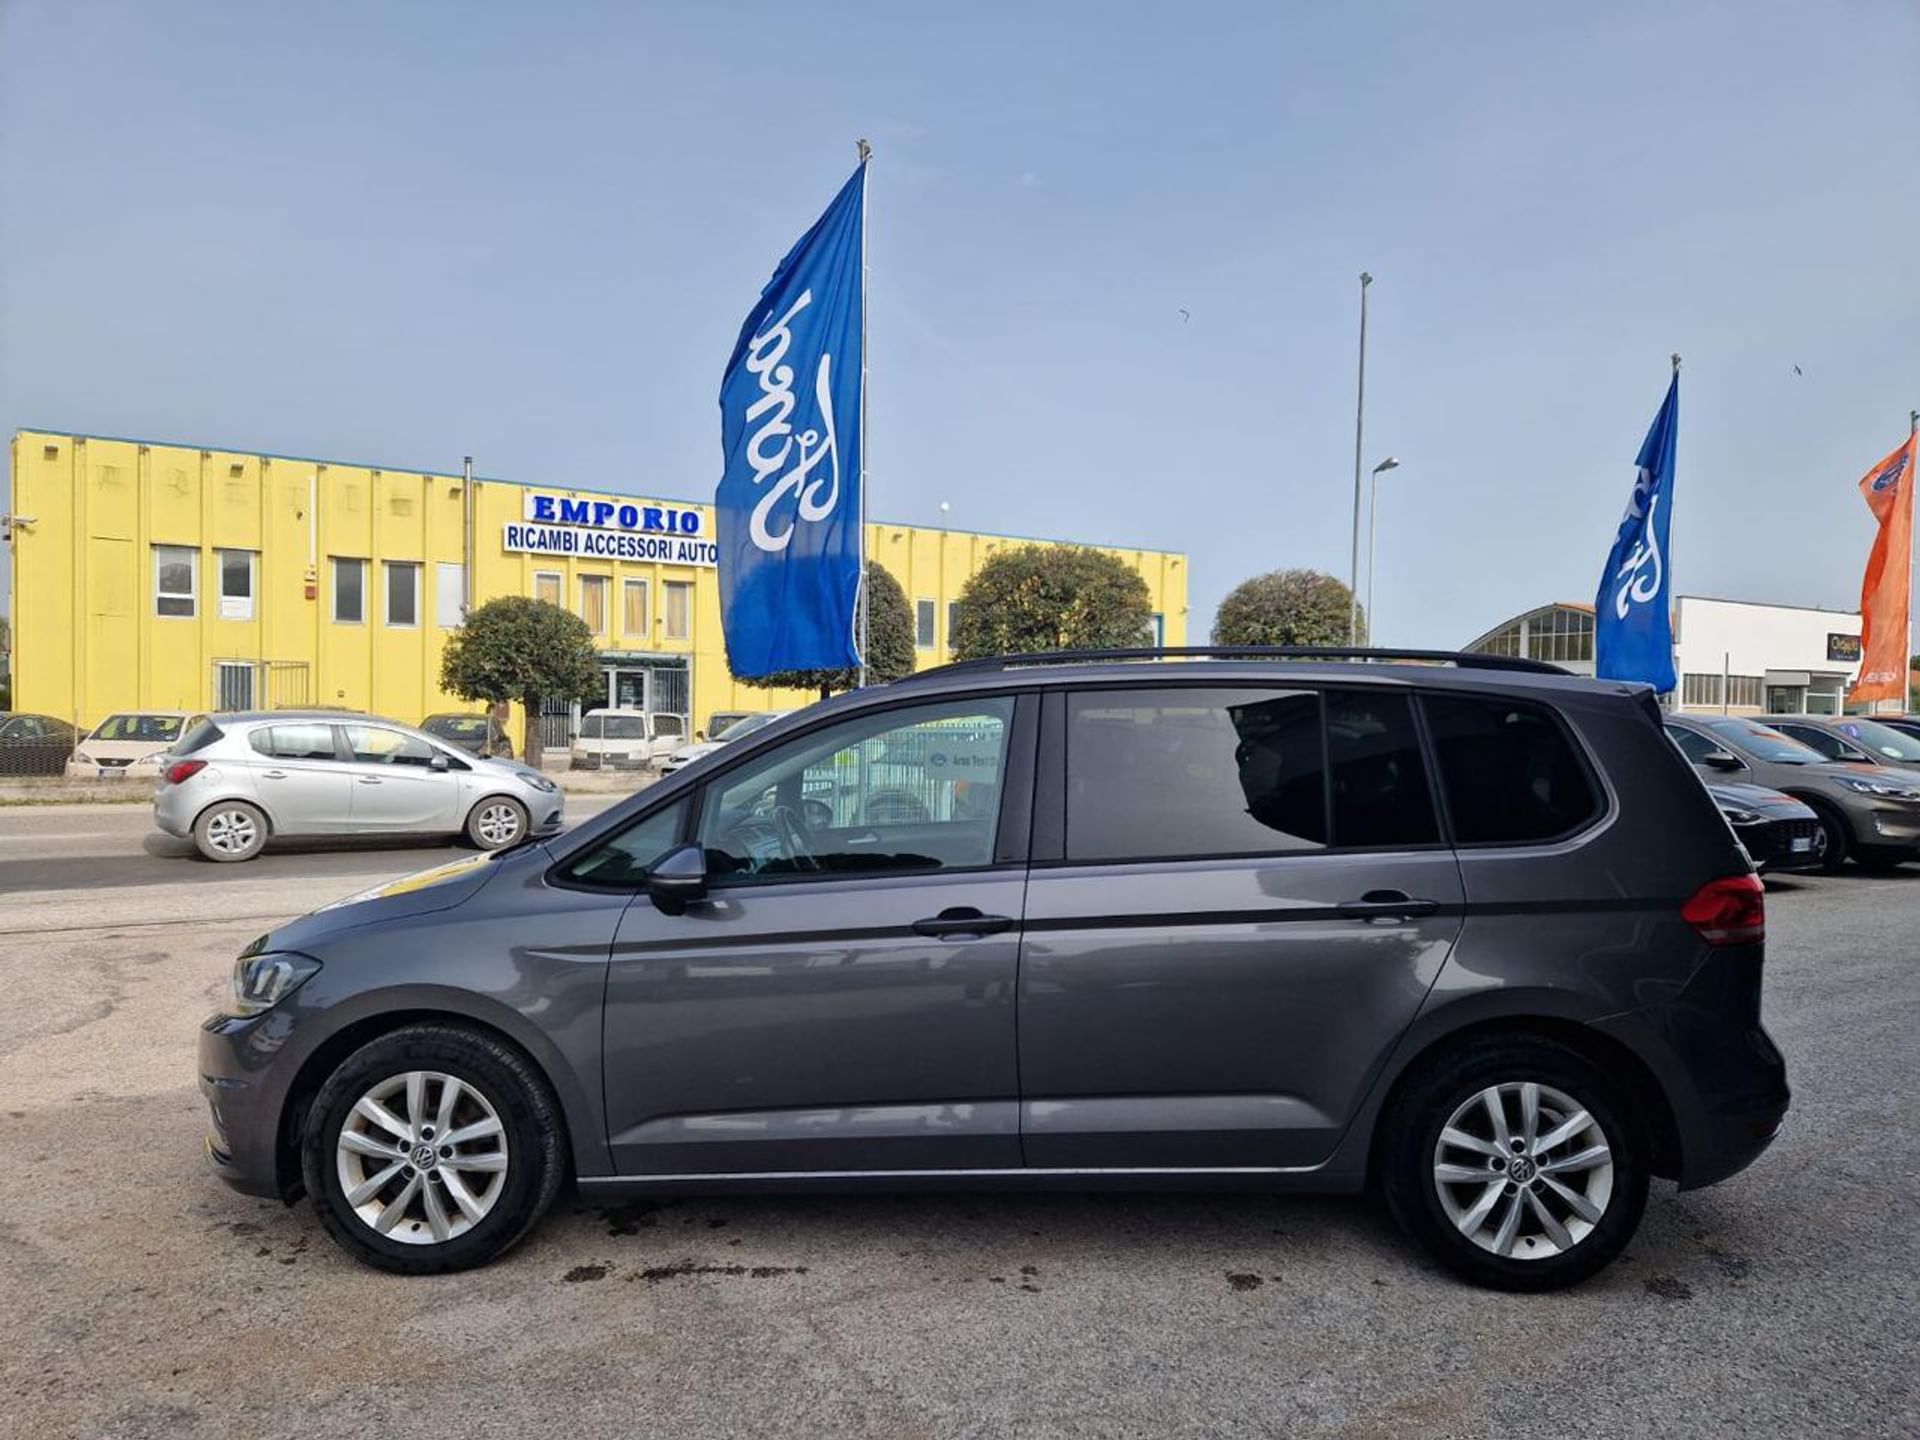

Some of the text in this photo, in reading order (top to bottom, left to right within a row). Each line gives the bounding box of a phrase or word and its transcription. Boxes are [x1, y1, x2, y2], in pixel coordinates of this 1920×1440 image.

[533, 495, 700, 534] EMPORIO
[507, 525, 718, 563] RICAMBI ACCESSORI AUTO
